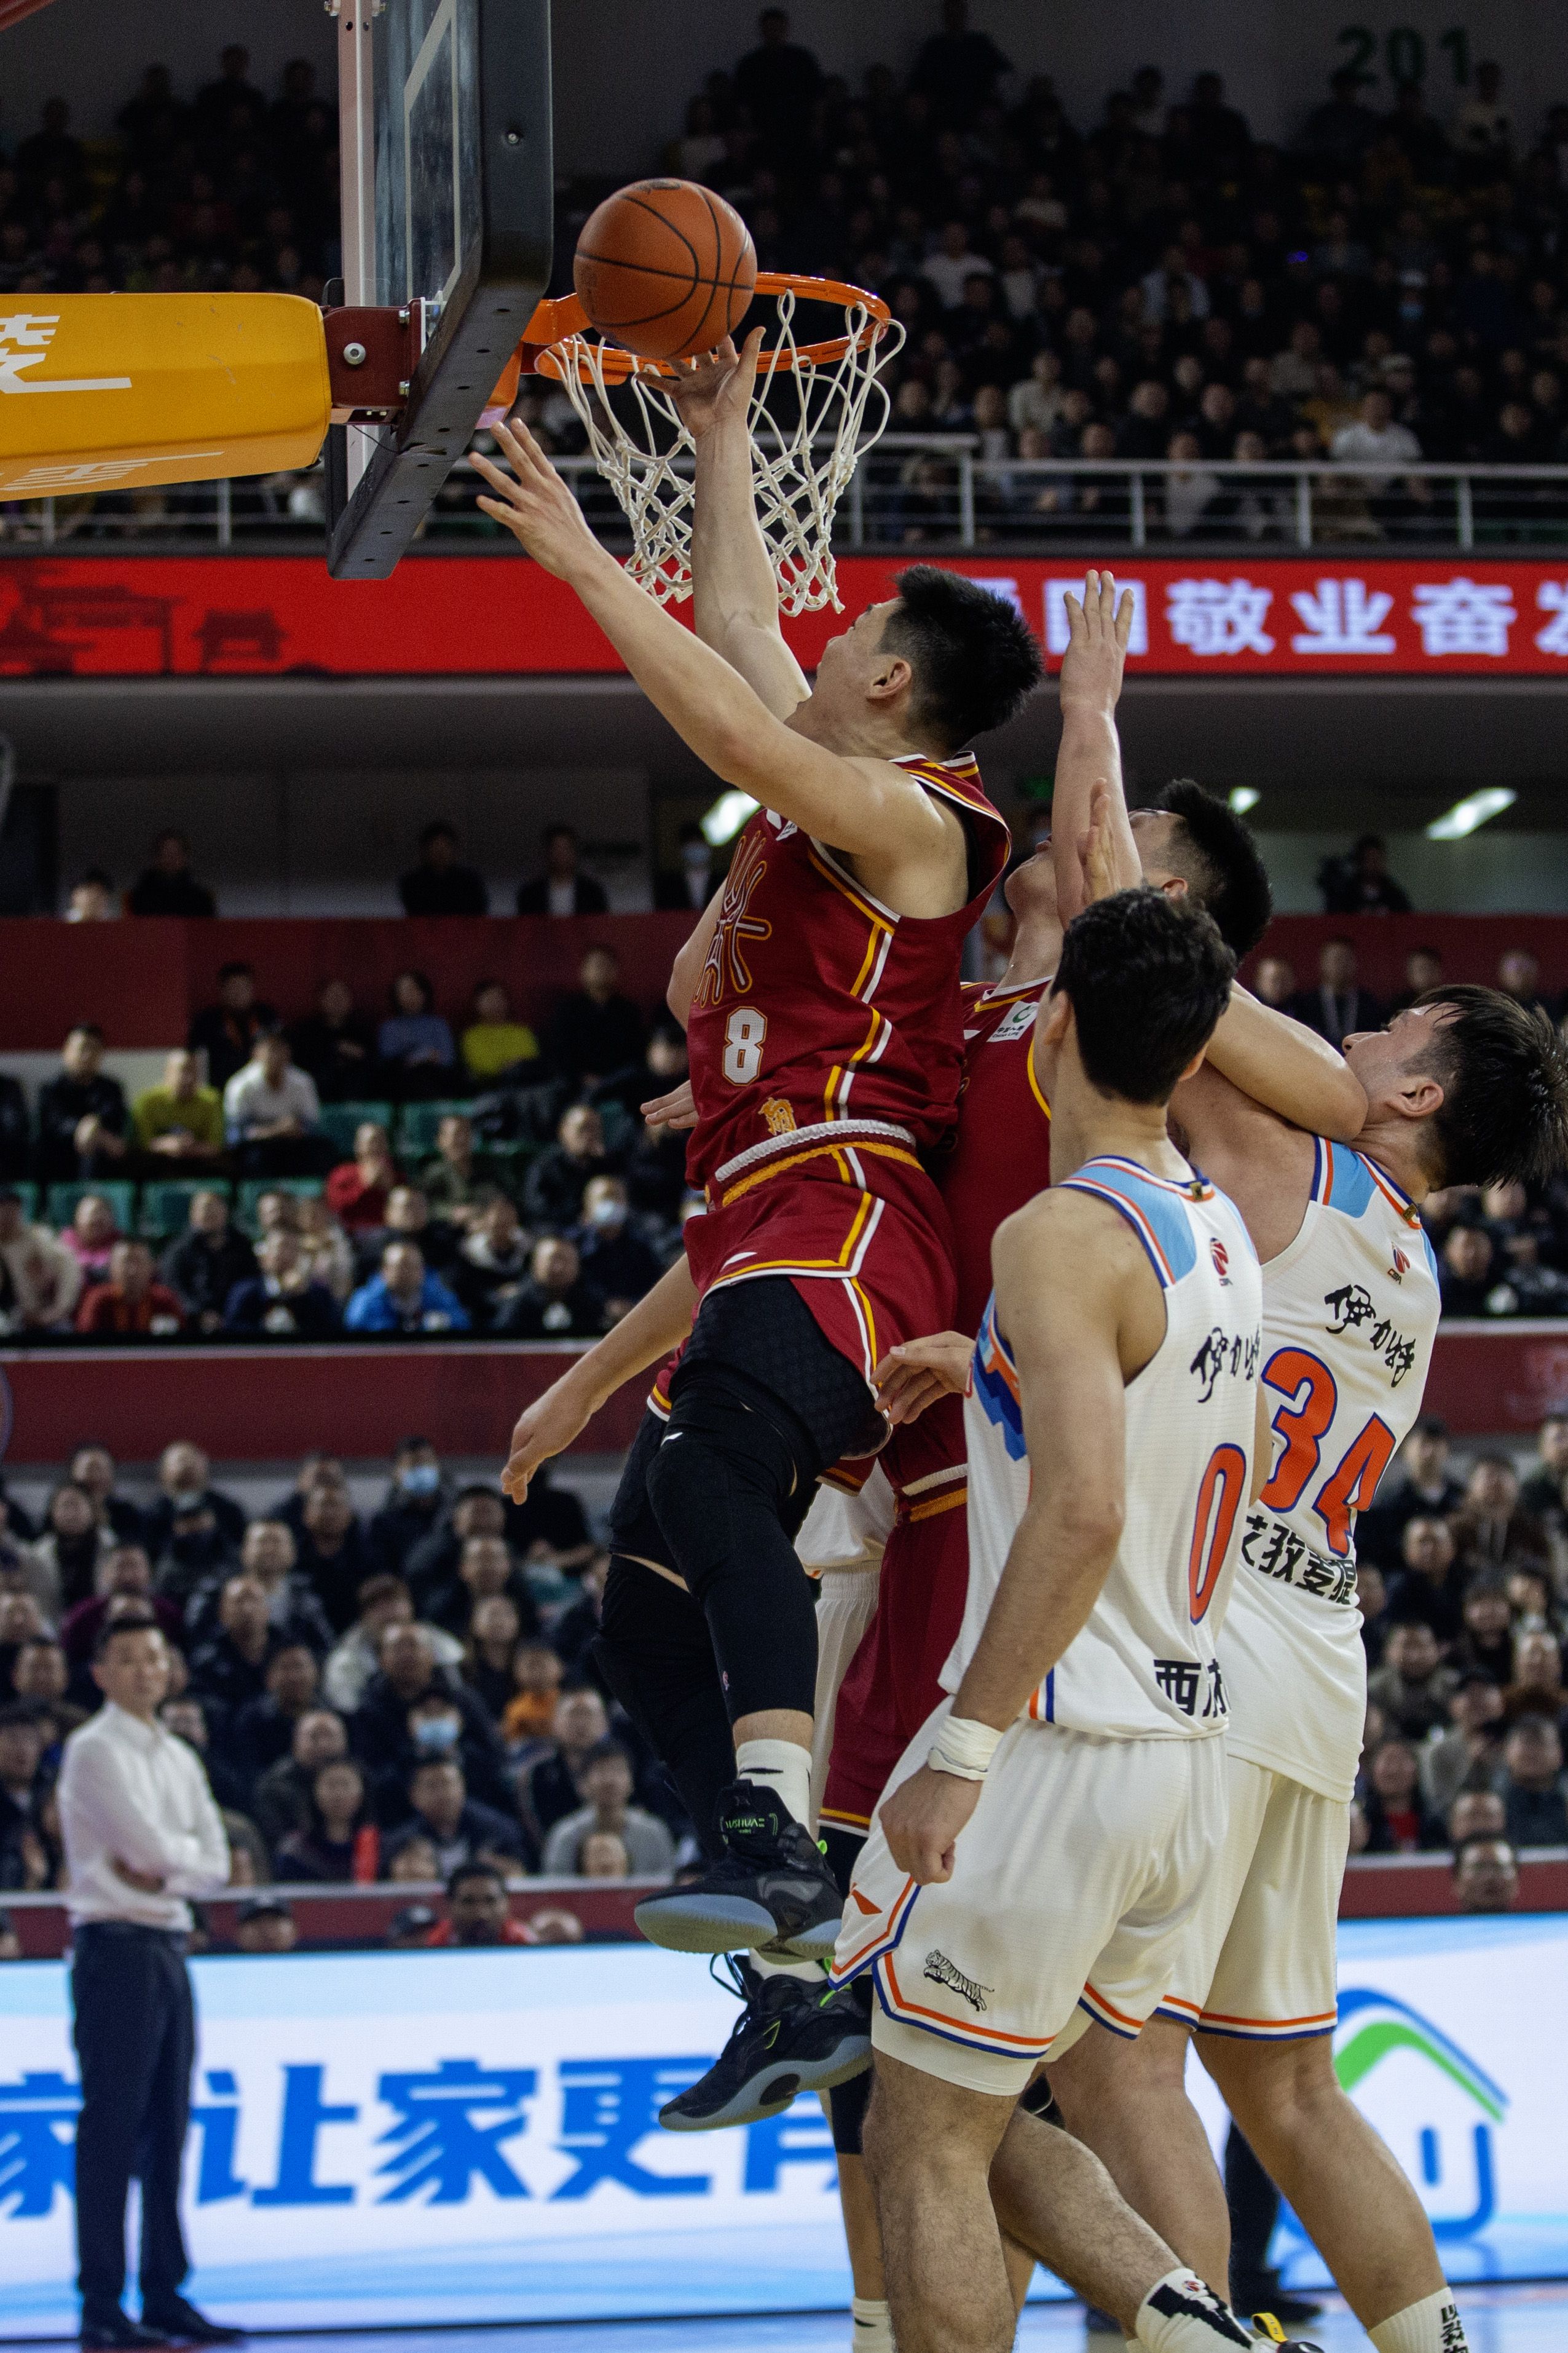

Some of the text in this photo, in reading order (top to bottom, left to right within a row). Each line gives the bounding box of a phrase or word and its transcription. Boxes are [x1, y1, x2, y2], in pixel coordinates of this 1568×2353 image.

[1333, 26, 1470, 87] 201
[722, 1006, 767, 1086] 8
[1259, 1346, 1397, 1559] 34
[1189, 1443, 1246, 1625] 0
